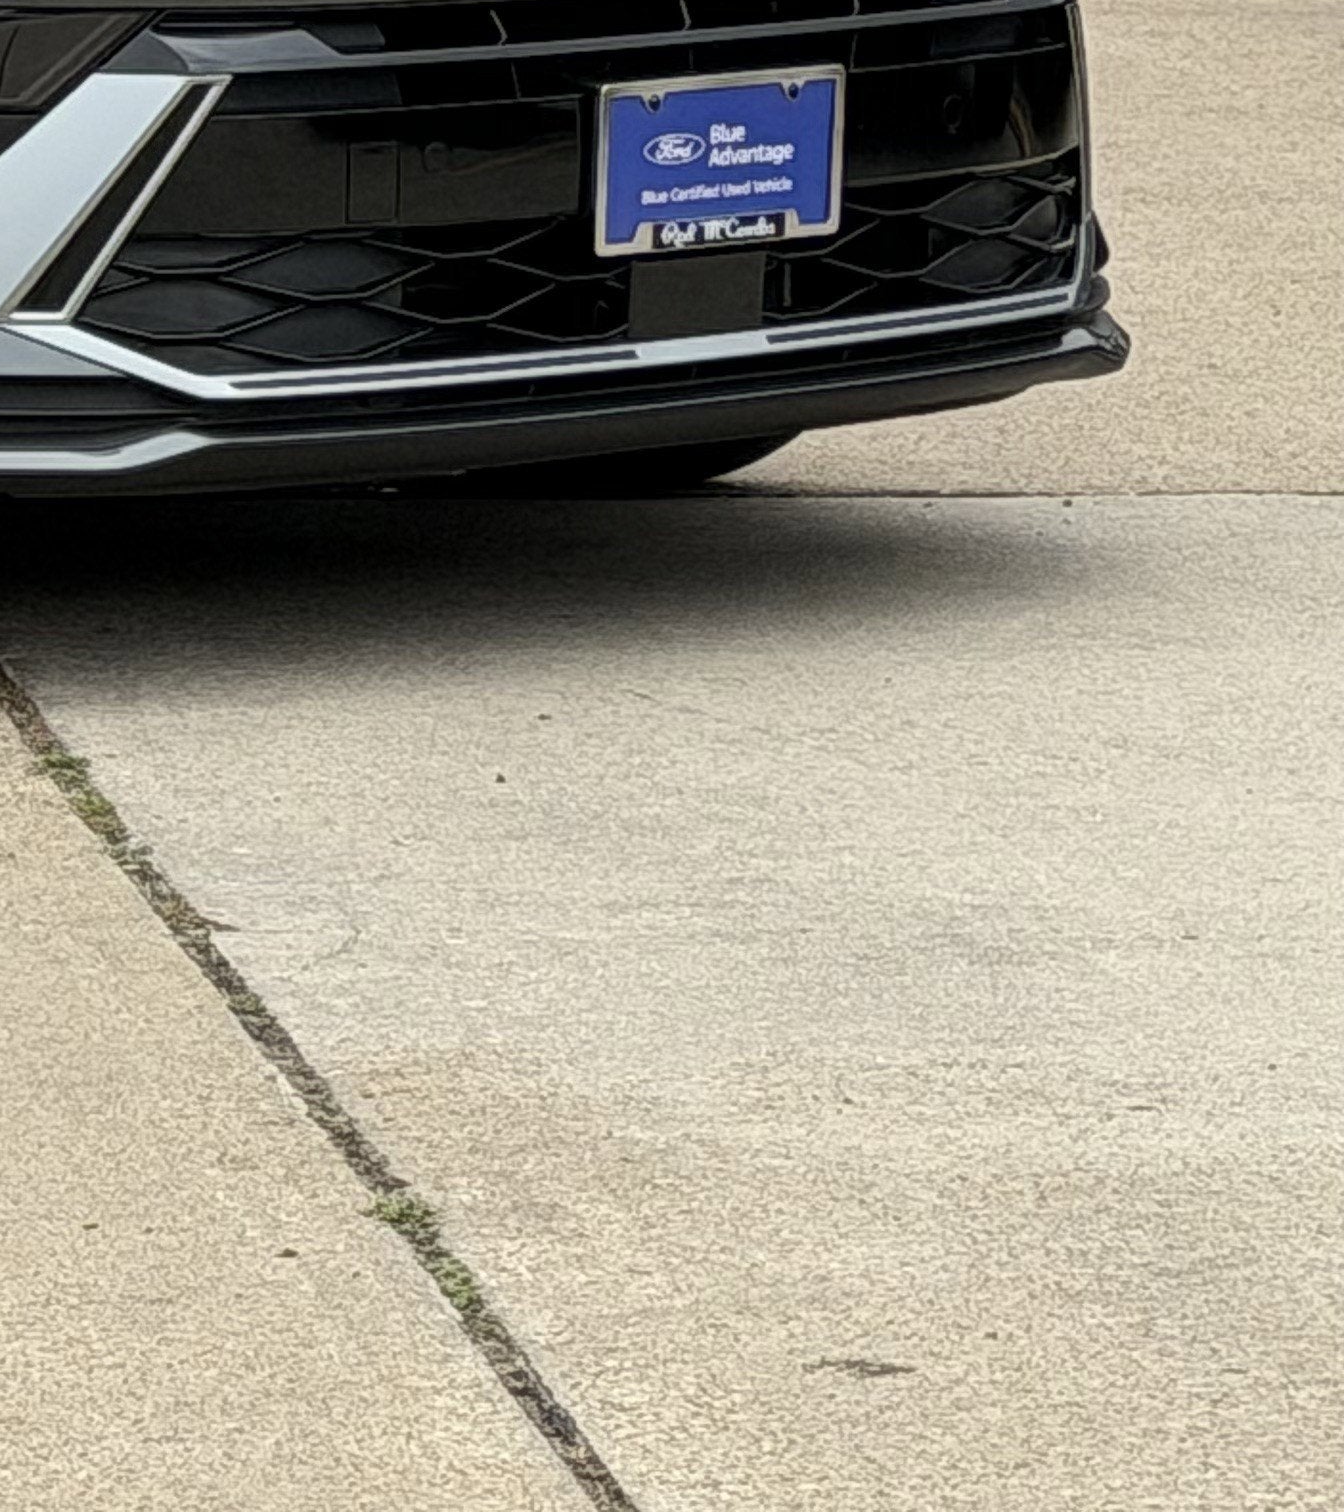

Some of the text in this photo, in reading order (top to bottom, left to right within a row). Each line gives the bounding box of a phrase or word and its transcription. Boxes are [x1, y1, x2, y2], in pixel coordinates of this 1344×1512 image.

[709, 123, 746, 145] Blue
[708, 143, 795, 167] Advantage
[641, 190, 669, 205] Blue
[670, 183, 720, 202] Certified
[721, 179, 751, 197] Used
